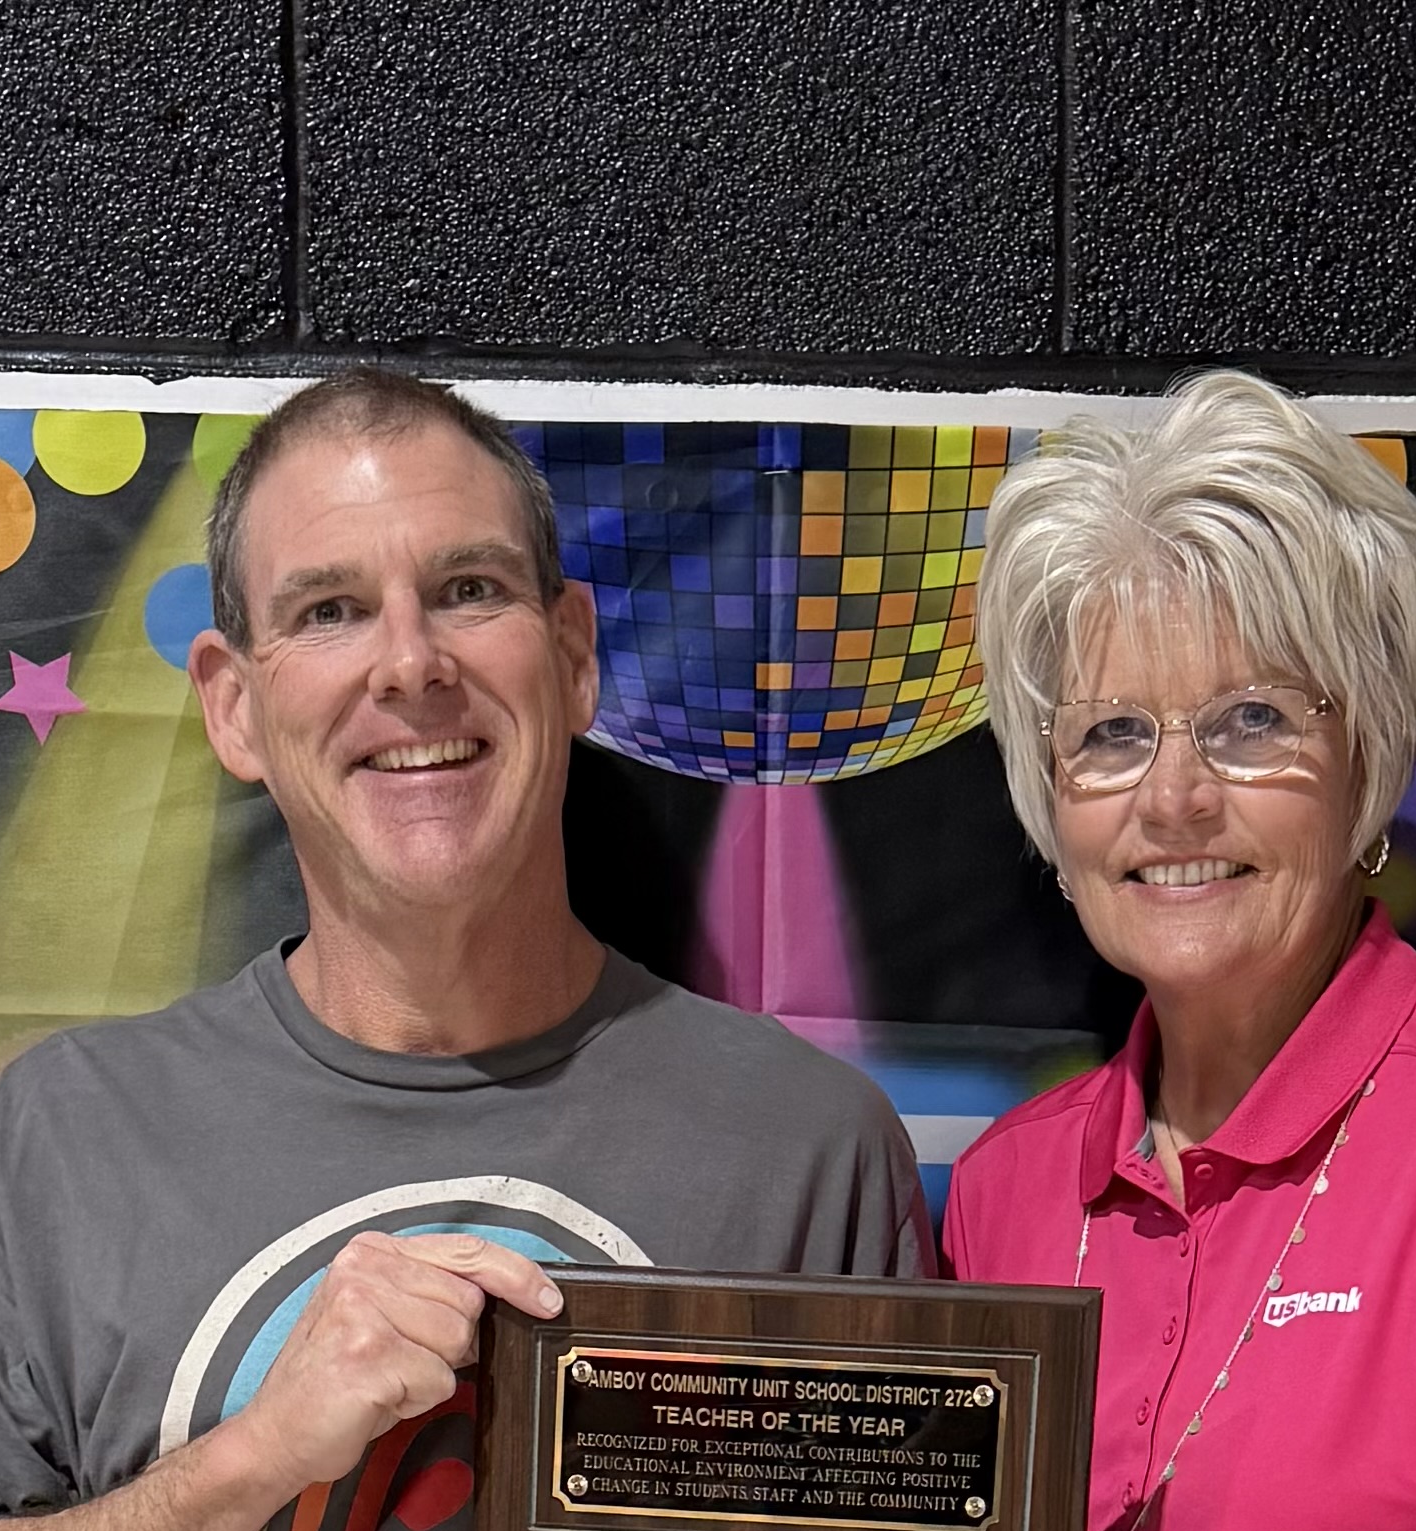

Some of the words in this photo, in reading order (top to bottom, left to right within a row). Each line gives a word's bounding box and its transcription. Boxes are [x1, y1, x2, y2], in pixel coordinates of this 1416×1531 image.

[588, 1369, 646, 1390] AMBOY
[650, 1373, 748, 1396] COMMUNITY
[752, 1378, 789, 1399] UNIT
[794, 1381, 861, 1402] SCHOOL
[866, 1385, 940, 1406] DISTRICT
[944, 1389, 974, 1408] 272
[652, 1405, 754, 1429] TEACHER
[761, 1411, 790, 1431] OF
[798, 1413, 841, 1433] THE
[848, 1416, 905, 1437] YEAR
[576, 1432, 667, 1452] RECOGNIZED
[671, 1438, 699, 1454] FOR
[704, 1440, 804, 1460] EXCEPTIONAL
[809, 1446, 924, 1467] CONTRIBUTIONS
[929, 1452, 947, 1468] TO
[952, 1453, 981, 1468] THE
[583, 1454, 690, 1475] EDUCATIONAL
[695, 1461, 808, 1481] ENVIRONMENT
[812, 1468, 897, 1487] AFFECTING
[902, 1473, 971, 1490] POSITIVE
[591, 1477, 649, 1494] CHANGE
[655, 1481, 670, 1495] IN
[752, 1486, 798, 1503] STAFF
[802, 1490, 834, 1505] AND
[837, 1491, 866, 1507] THE
[870, 1493, 960, 1511] COMMUNITY
